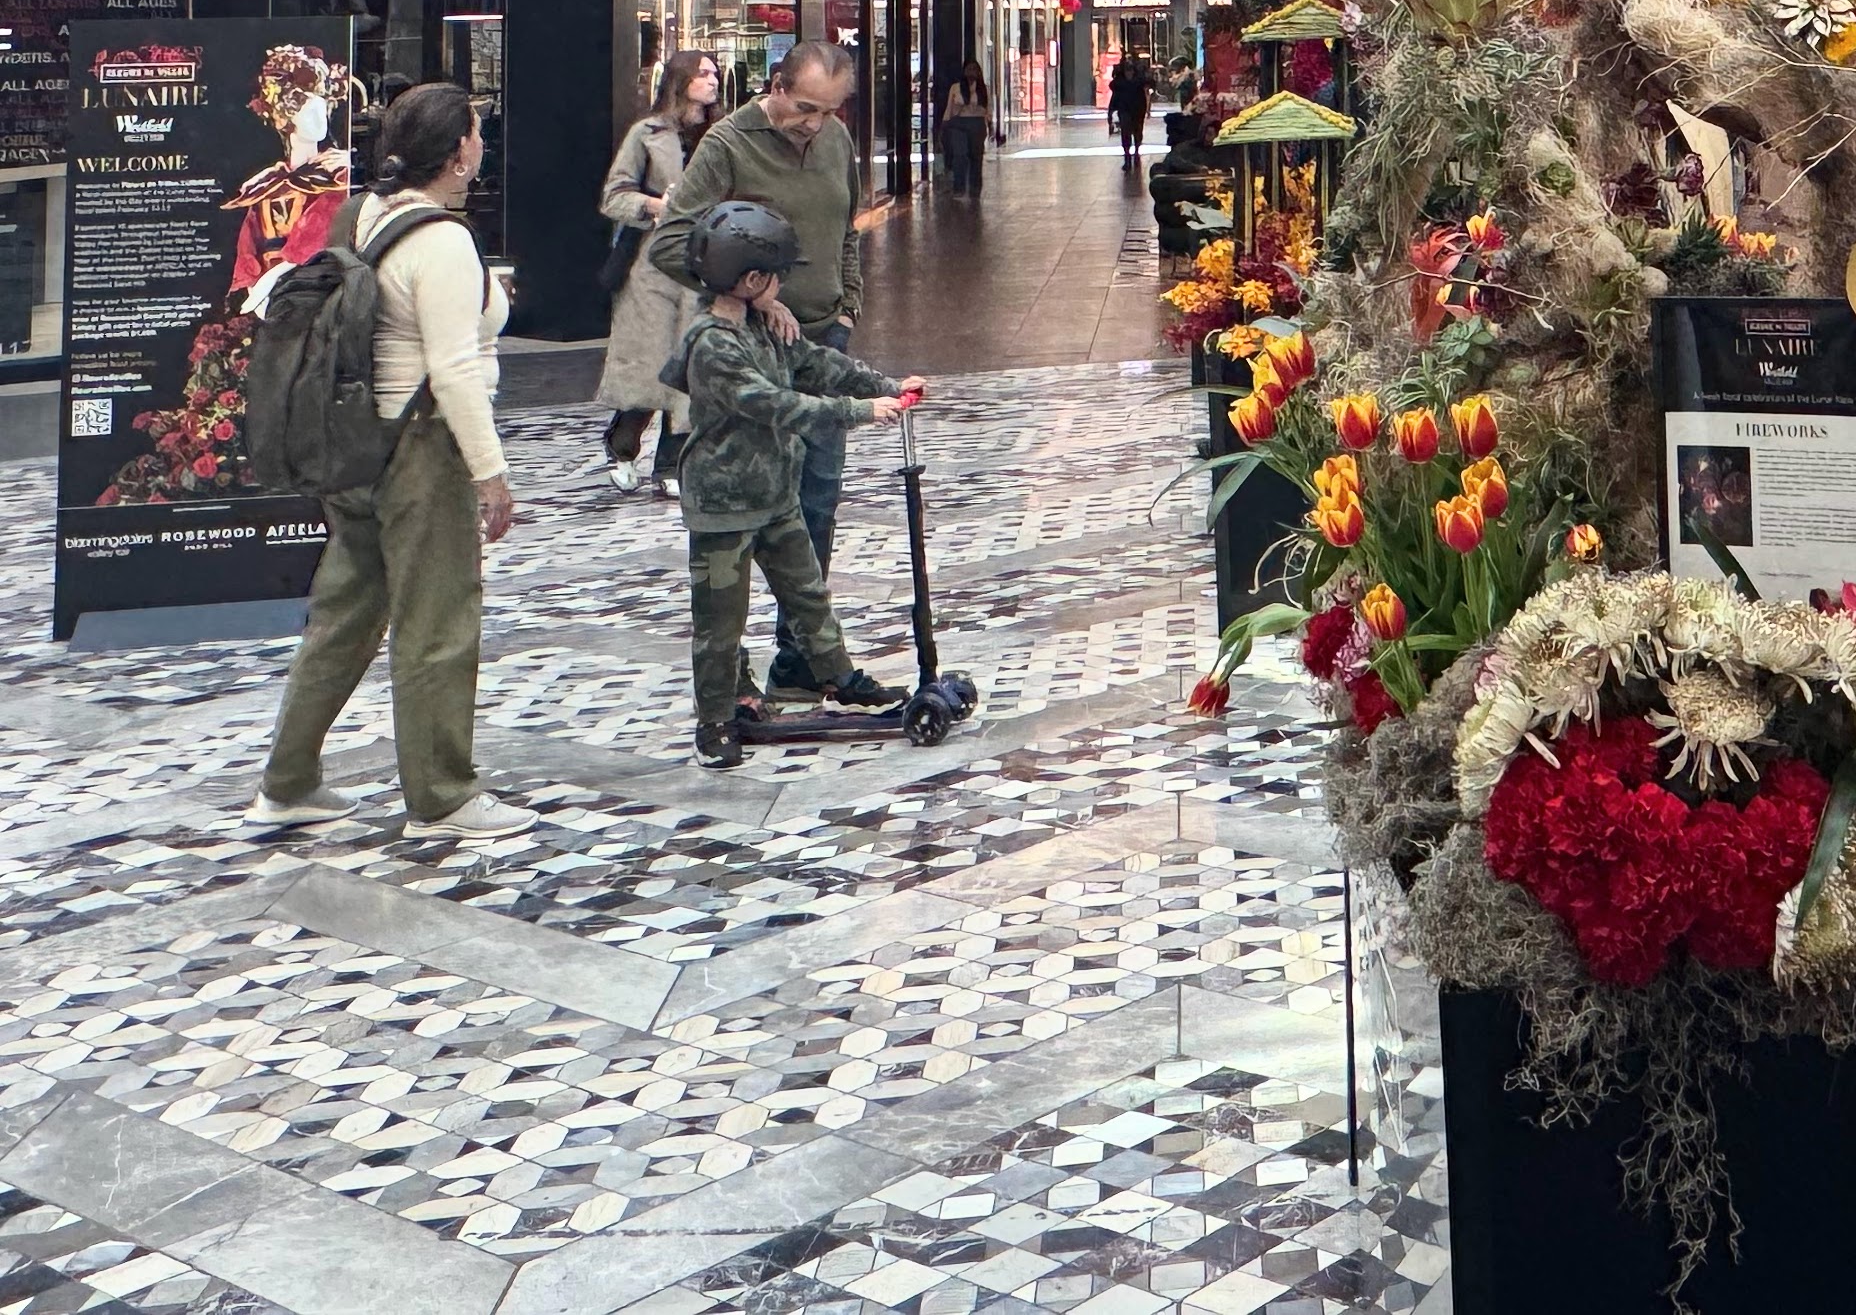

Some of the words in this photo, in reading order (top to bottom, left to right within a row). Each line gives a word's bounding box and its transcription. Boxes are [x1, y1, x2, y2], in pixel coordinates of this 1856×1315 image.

[3, 80, 31, 91] ALL
[77, 155, 189, 173] WELCOME
[1736, 422, 1829, 438] FIREWORKS
[161, 527, 257, 542] ROSEWOOD
